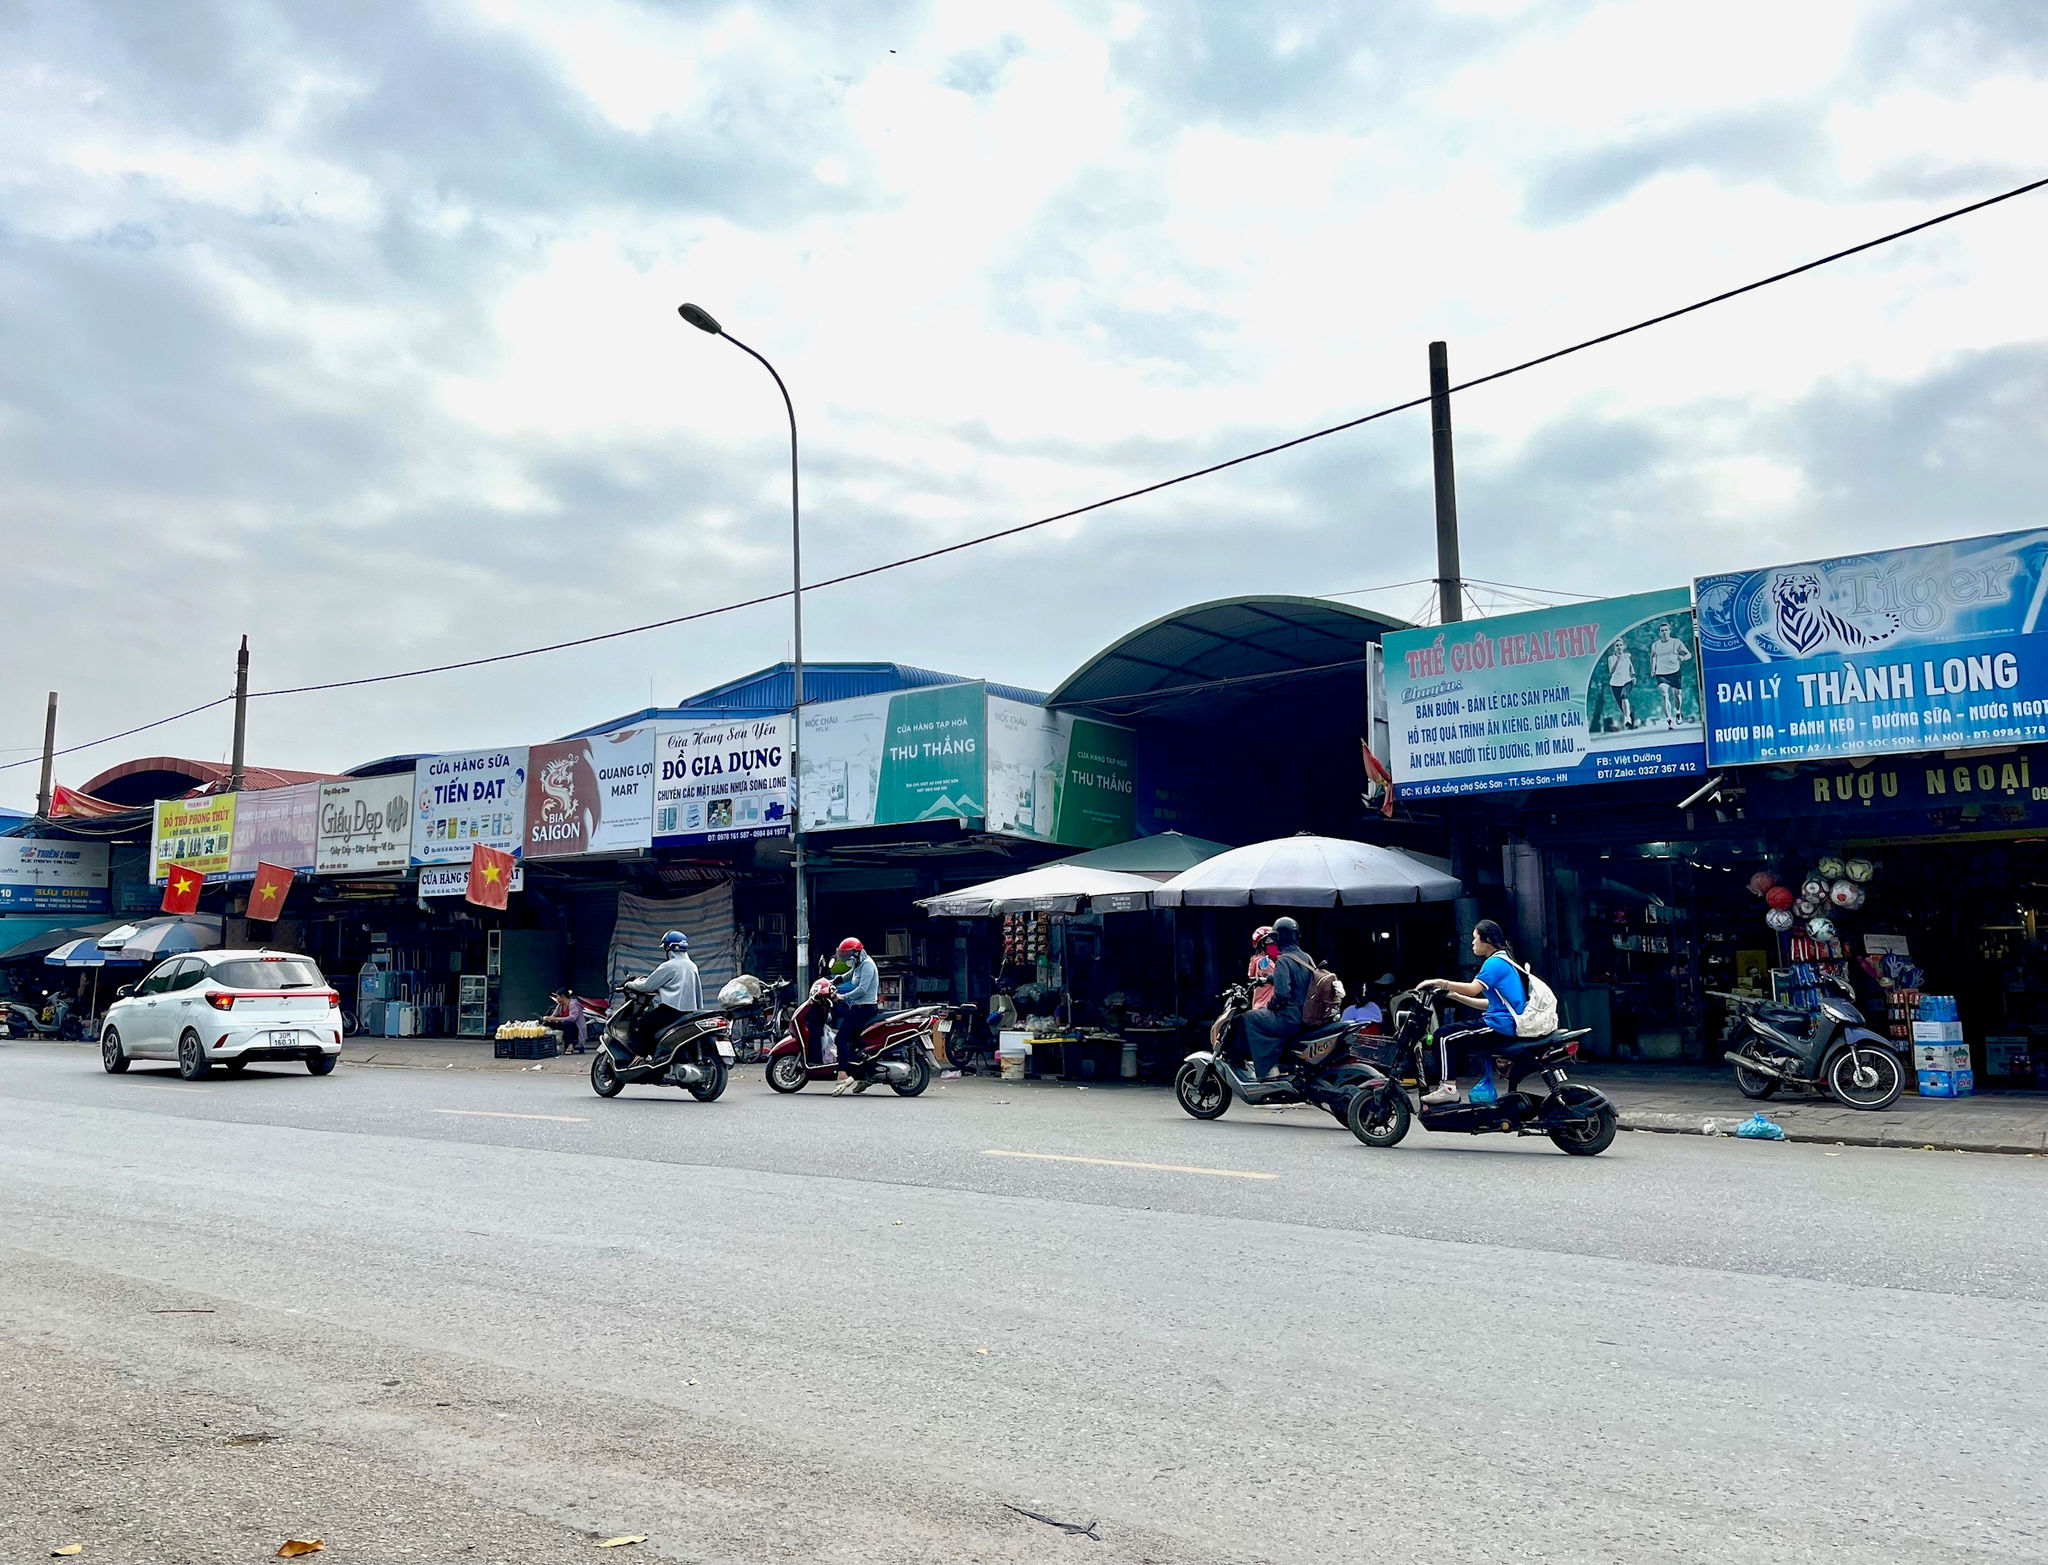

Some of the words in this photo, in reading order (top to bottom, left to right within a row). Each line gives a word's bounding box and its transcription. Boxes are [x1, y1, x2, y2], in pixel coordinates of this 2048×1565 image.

[1837, 557, 2016, 633] Tiger
[1406, 633, 1446, 680] THẾ
[1451, 632, 1495, 673] GIỚI
[1500, 623, 1599, 667] HEALTHY
[1717, 680, 1752, 705] ĐẠI
[1760, 673, 1782, 700] LÝ
[1797, 662, 1914, 708] THÀNH
[1924, 652, 2019, 697] LONG
[1416, 702, 1434, 719] BÁN
[1436, 699, 1459, 717] BUÔN
[1467, 695, 1486, 713] BÁN
[1501, 690, 1519, 709] CÁC
[1521, 686, 1540, 706] SẢN
[1543, 681, 1570, 704] PHẨM
[897, 723, 912, 734] CỬA
[913, 719, 934, 731] HÀNG
[936, 720, 950, 731] TẠP
[1421, 726, 1437, 745] TRỢ
[1440, 722, 1457, 742] QUÁ
[1459, 720, 1485, 739] TRÌNH
[1488, 719, 1500, 736] ĂN
[1535, 710, 1559, 731] GIẢM
[1715, 724, 1749, 743] RƯỢU
[1753, 724, 1774, 740] BIA
[1790, 717, 1825, 737] BÁNH
[1829, 717, 1855, 734] KẸO
[1872, 708, 1919, 729] ĐƯỜNG
[1923, 706, 1952, 725] SỮA
[1969, 701, 2008, 721] NƯỚC
[1973, 730, 1990, 739] ĐT:
[1993, 728, 2021, 737] 0984
[2024, 725, 2046, 735] 378
[890, 745, 918, 761] THU
[923, 735, 976, 757] THẮNG
[1410, 752, 1422, 769] ĂN
[1424, 752, 1447, 767] CHAY,
[1449, 745, 1476, 765] NGƯỜI
[1478, 741, 1497, 762] TIỂU
[1500, 740, 1533, 760] ĐƯỜNG,
[1536, 737, 1550, 756] MỠ
[1553, 736, 1574, 754] MÁU
[1596, 757, 1612, 766] FB:
[1613, 755, 1631, 765] Việt
[1633, 753, 1662, 763] Dưỡng
[430, 759, 450, 776] CỬA
[453, 757, 484, 773] HÀNG
[488, 754, 510, 768] SỮA
[599, 765, 634, 780] QUANG
[637, 762, 653, 779] LỢI
[662, 749, 687, 780] ĐỒ
[692, 755, 724, 777] GIA
[728, 747, 782, 777] DỤNG
[1614, 768, 1637, 778] Zalo:
[1638, 765, 1659, 776] 0327
[1661, 764, 1676, 773] 367
[1679, 762, 1696, 772] 412
[435, 777, 468, 805] TIẾN
[473, 778, 505, 804] ĐẠT
[611, 783, 639, 797] MART
[658, 786, 681, 801] CHUYÊN
[683, 785, 695, 799] CÁC
[696, 784, 710, 799] MẶT
[711, 782, 729, 795] HÀNG
[730, 780, 748, 795] NHỰA
[749, 778, 767, 791] SONG
[769, 776, 787, 789] LONG
[1071, 769, 1094, 786] THU
[1097, 771, 1133, 794] THẮNG
[1401, 788, 1414, 797] ĐC:
[1432, 785, 1441, 794] A2
[1460, 783, 1473, 792] chợ
[1474, 781, 1488, 790] Sóc
[1488, 780, 1503, 789] Sơn
[1508, 778, 1519, 787] TT.
[1520, 776, 1535, 786] Sóc
[1536, 776, 1550, 785] Sơn
[1556, 773, 1568, 783] HN
[1813, 770, 1898, 806] RƯỢU
[189, 812, 211, 825] PHONG
[353, 800, 383, 841] Đẹp
[549, 813, 564, 824] BIA
[532, 822, 580, 842] SAIGON
[422, 870, 438, 885] CỬA
[440, 870, 462, 885] HÀNG
